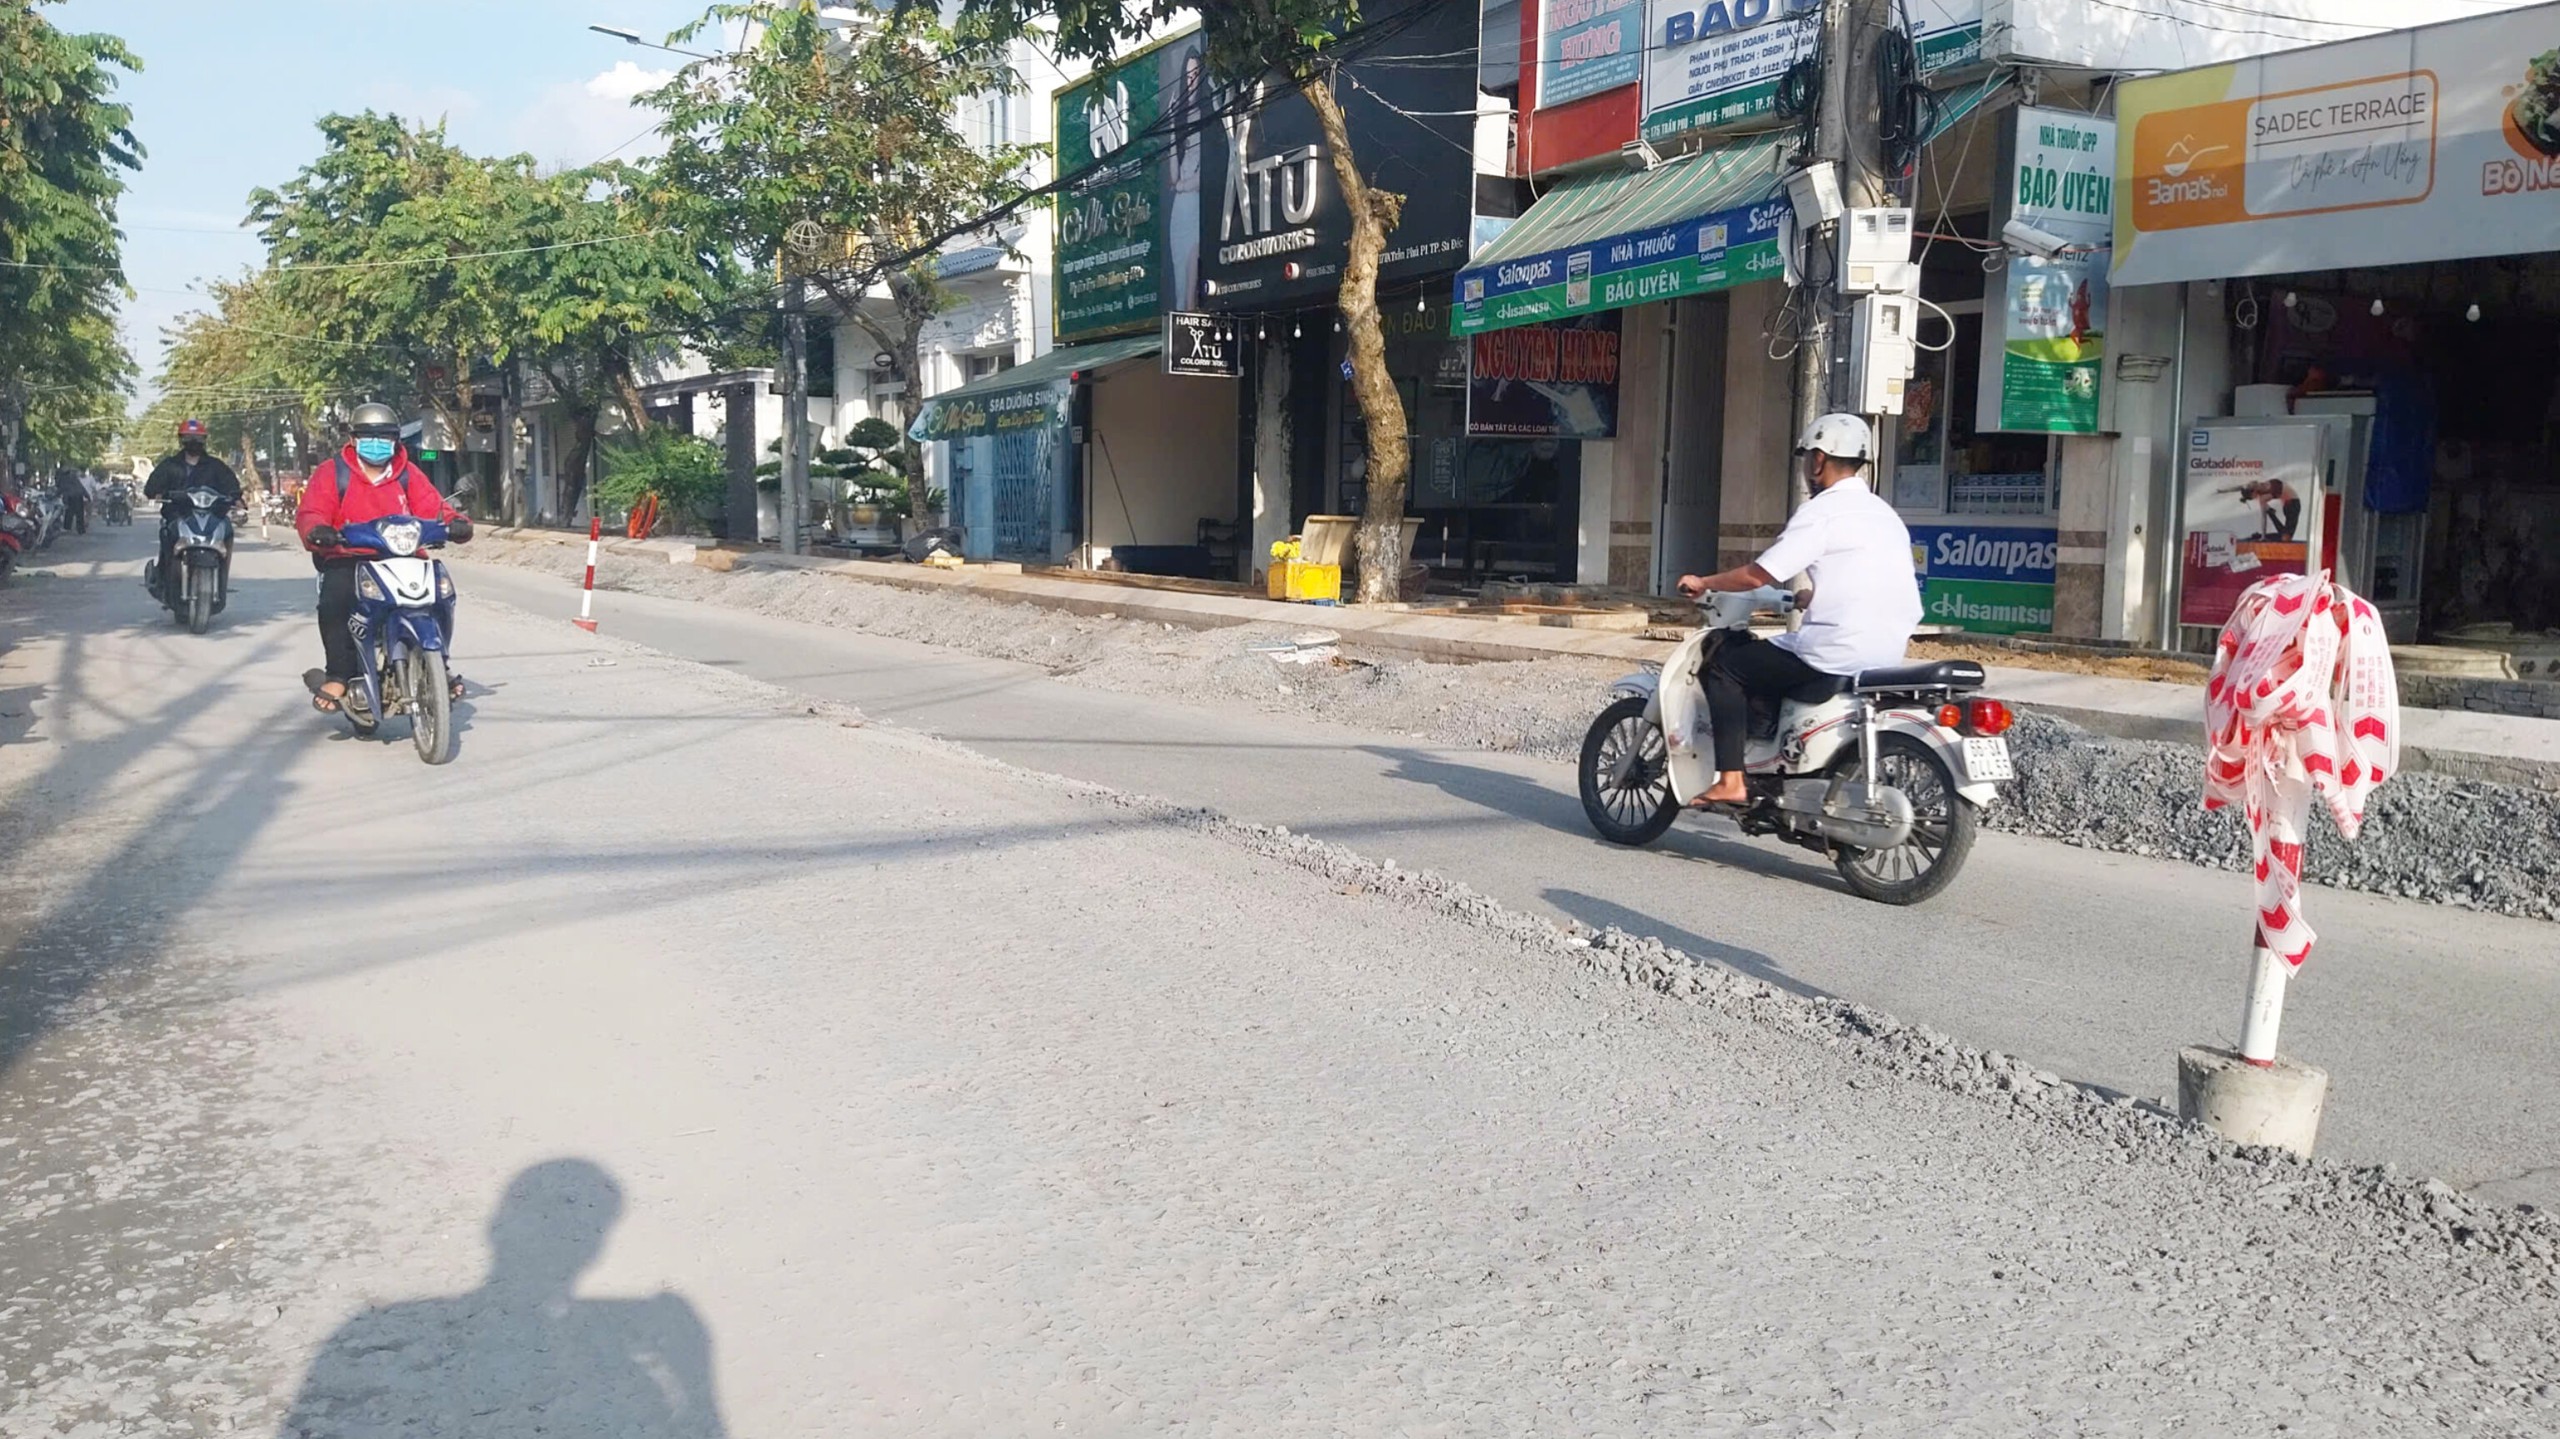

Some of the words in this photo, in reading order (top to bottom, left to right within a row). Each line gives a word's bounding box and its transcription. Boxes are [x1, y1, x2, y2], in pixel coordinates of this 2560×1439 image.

[1712, 48, 1720, 57] VI
[1722, 42, 1740, 55] KINH
[1742, 33, 1769, 48] DOANH
[1730, 51, 1755, 66] TRÁCH
[2253, 108, 2322, 137] SADEC
[2328, 92, 2428, 126] TERRACE
[2040, 123, 2056, 148] NHÀ
[2057, 123, 2081, 151] THUỐC
[2019, 153, 2058, 209] BẢO
[2062, 165, 2111, 215] UYÊN
[1219, 228, 1315, 264] COLORWORKS
[1611, 240, 1634, 264] NHÀ
[1637, 233, 1676, 257] THUỐC
[1496, 259, 1552, 288] Salonpas
[1605, 275, 1637, 303] BẢO
[1639, 271, 1680, 298] UYÊN
[1176, 316, 1200, 327] HAIR
[1201, 318, 1234, 329] SALON
[1496, 301, 1550, 320] Hisamitsu
[1180, 357, 1229, 368] COLORWORKS
[989, 397, 1005, 413] SPA
[2191, 456, 2236, 469] Glotadol
[1934, 532, 2058, 576] Salonpas
[1930, 592, 2055, 625] Hisamitsu
